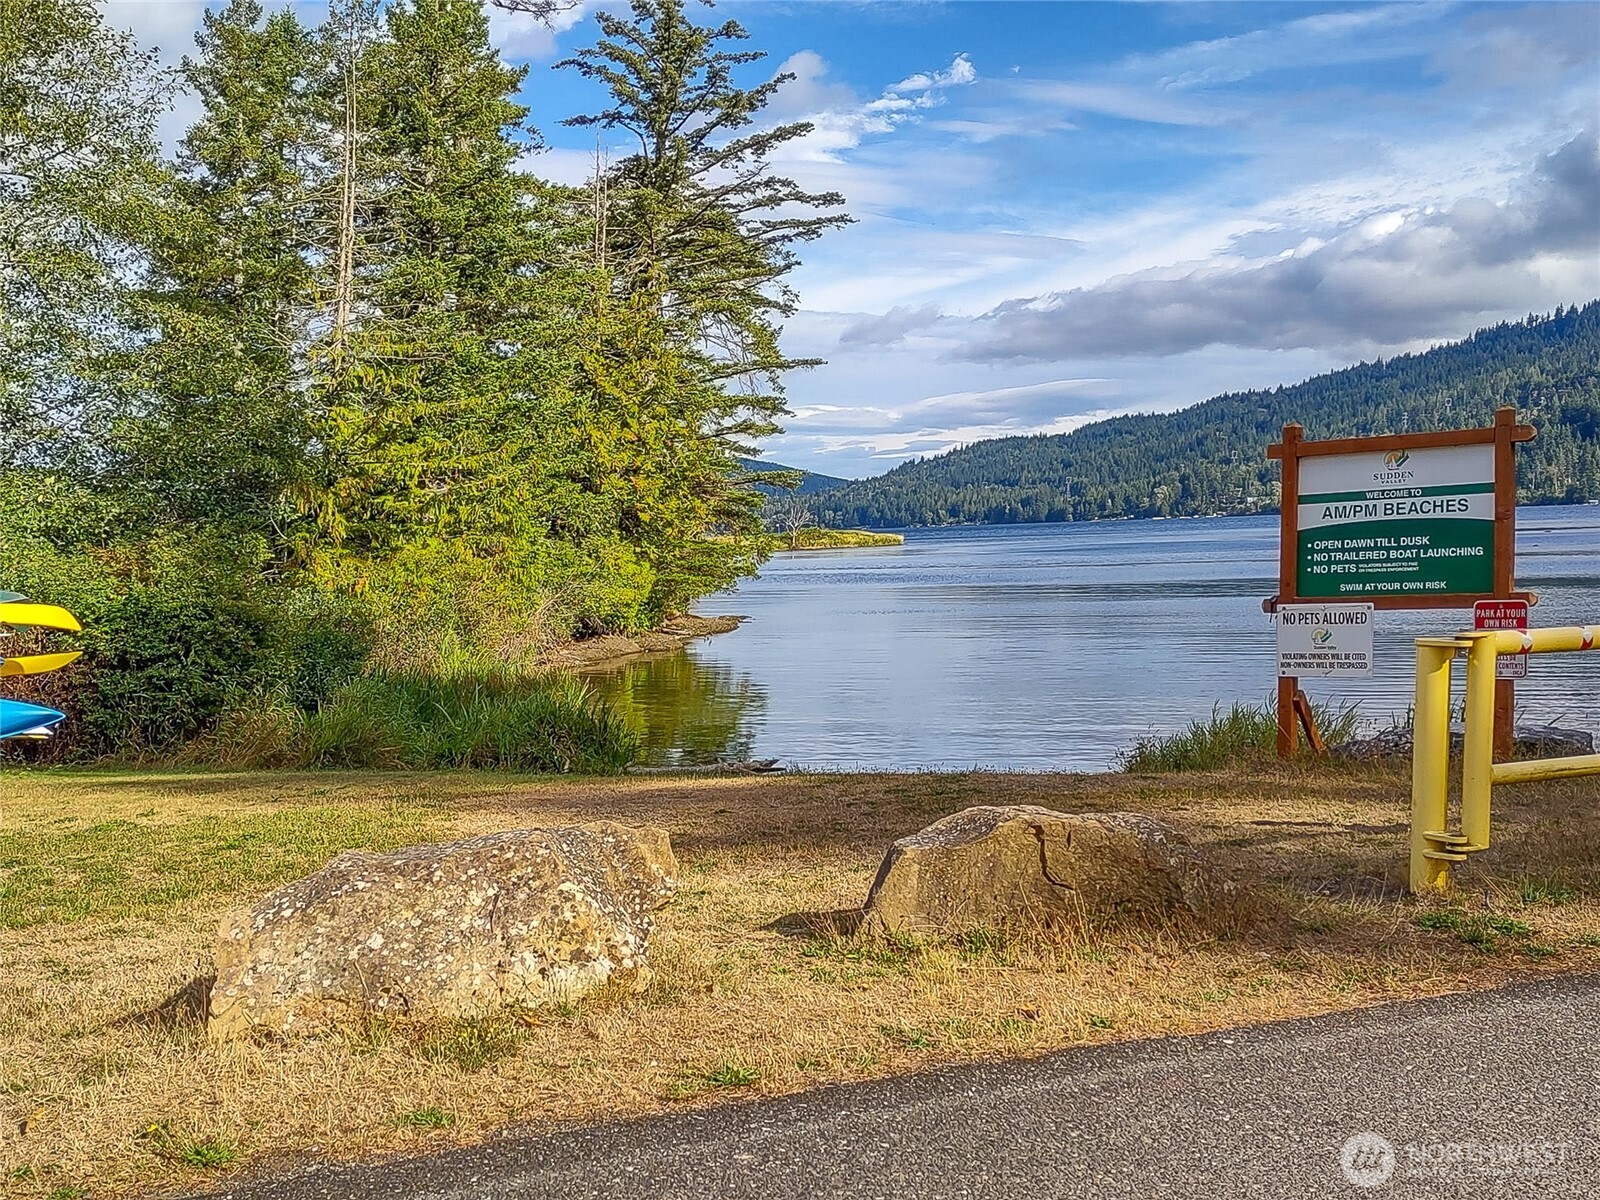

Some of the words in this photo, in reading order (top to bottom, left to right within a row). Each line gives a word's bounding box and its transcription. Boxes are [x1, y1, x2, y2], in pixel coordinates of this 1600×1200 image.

[1373, 471, 1414, 480] SUDDEN
[1366, 490, 1409, 499] WELCOME
[1322, 504, 1377, 519] AM/PM
[1384, 499, 1469, 516] BEACHES
[1314, 540, 1342, 550] OPEN
[1344, 538, 1374, 548] DAWN
[1376, 538, 1397, 547] TILL
[1400, 536, 1430, 546] DUSK
[1313, 553, 1328, 561] NO
[1330, 551, 1386, 561] TRAILERED
[1390, 549, 1418, 558] BOAT
[1420, 547, 1484, 557] LAUNCHING
[1313, 565, 1328, 574] NO
[1331, 564, 1356, 573] PETS
[1340, 583, 1363, 591] SWIM
[1364, 583, 1376, 591] AT
[1377, 582, 1400, 590] YOUR
[1426, 581, 1447, 589] RISK
[1477, 609, 1495, 617] PARK
[1496, 609, 1504, 617] AT
[1506, 609, 1525, 617] YOUR
[1282, 613, 1296, 625] NO
[1298, 613, 1320, 624] PETS
[1322, 612, 1367, 624] ALLOWED
[1484, 619, 1500, 627] OWN
[1501, 619, 1517, 627] RISK
